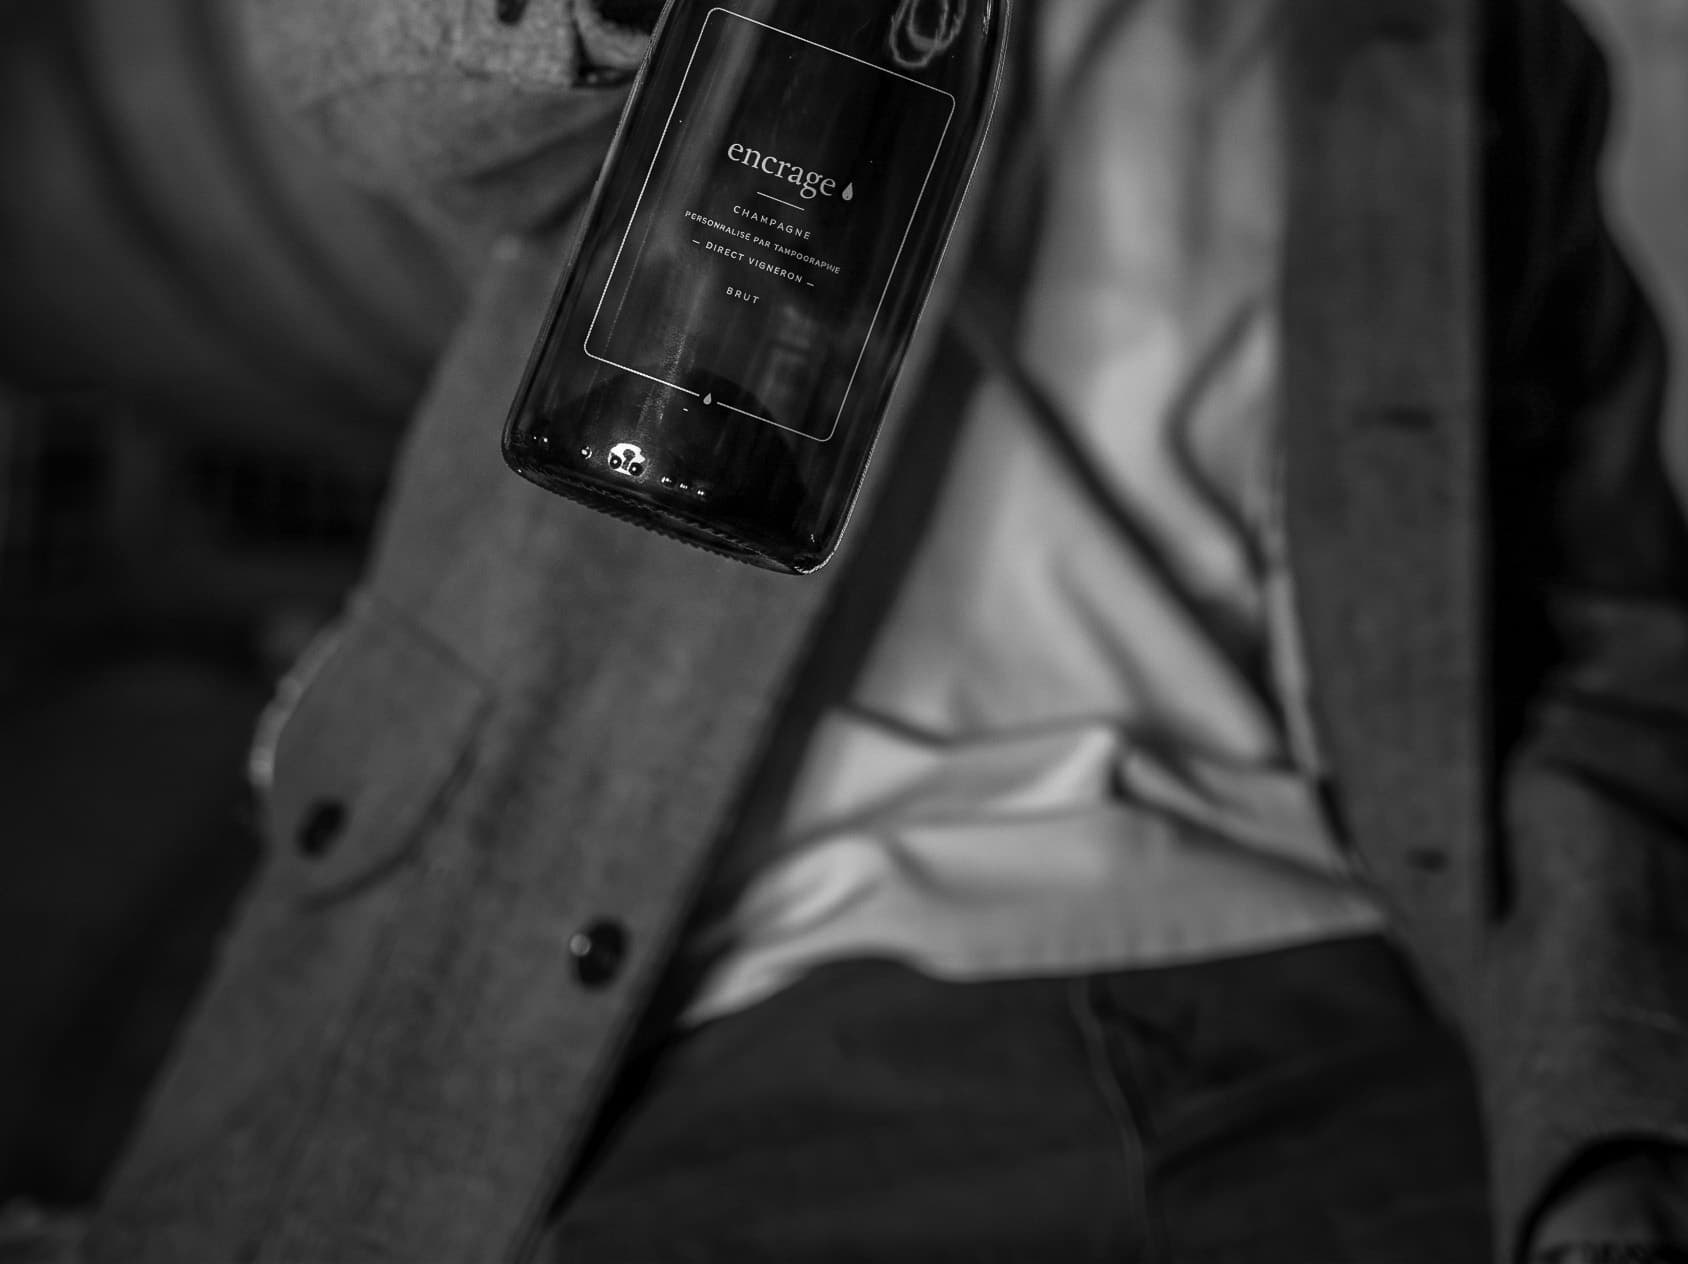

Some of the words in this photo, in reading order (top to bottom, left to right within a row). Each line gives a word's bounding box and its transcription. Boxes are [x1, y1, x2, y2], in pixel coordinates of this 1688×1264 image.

[727, 142, 837, 199] encrage
[733, 205, 812, 240] CHAMPAGNE
[753, 236, 771, 248] PAR
[705, 241, 745, 262] DIRECT
[748, 257, 803, 283] VIGNERON
[726, 286, 760, 304] BRUT
